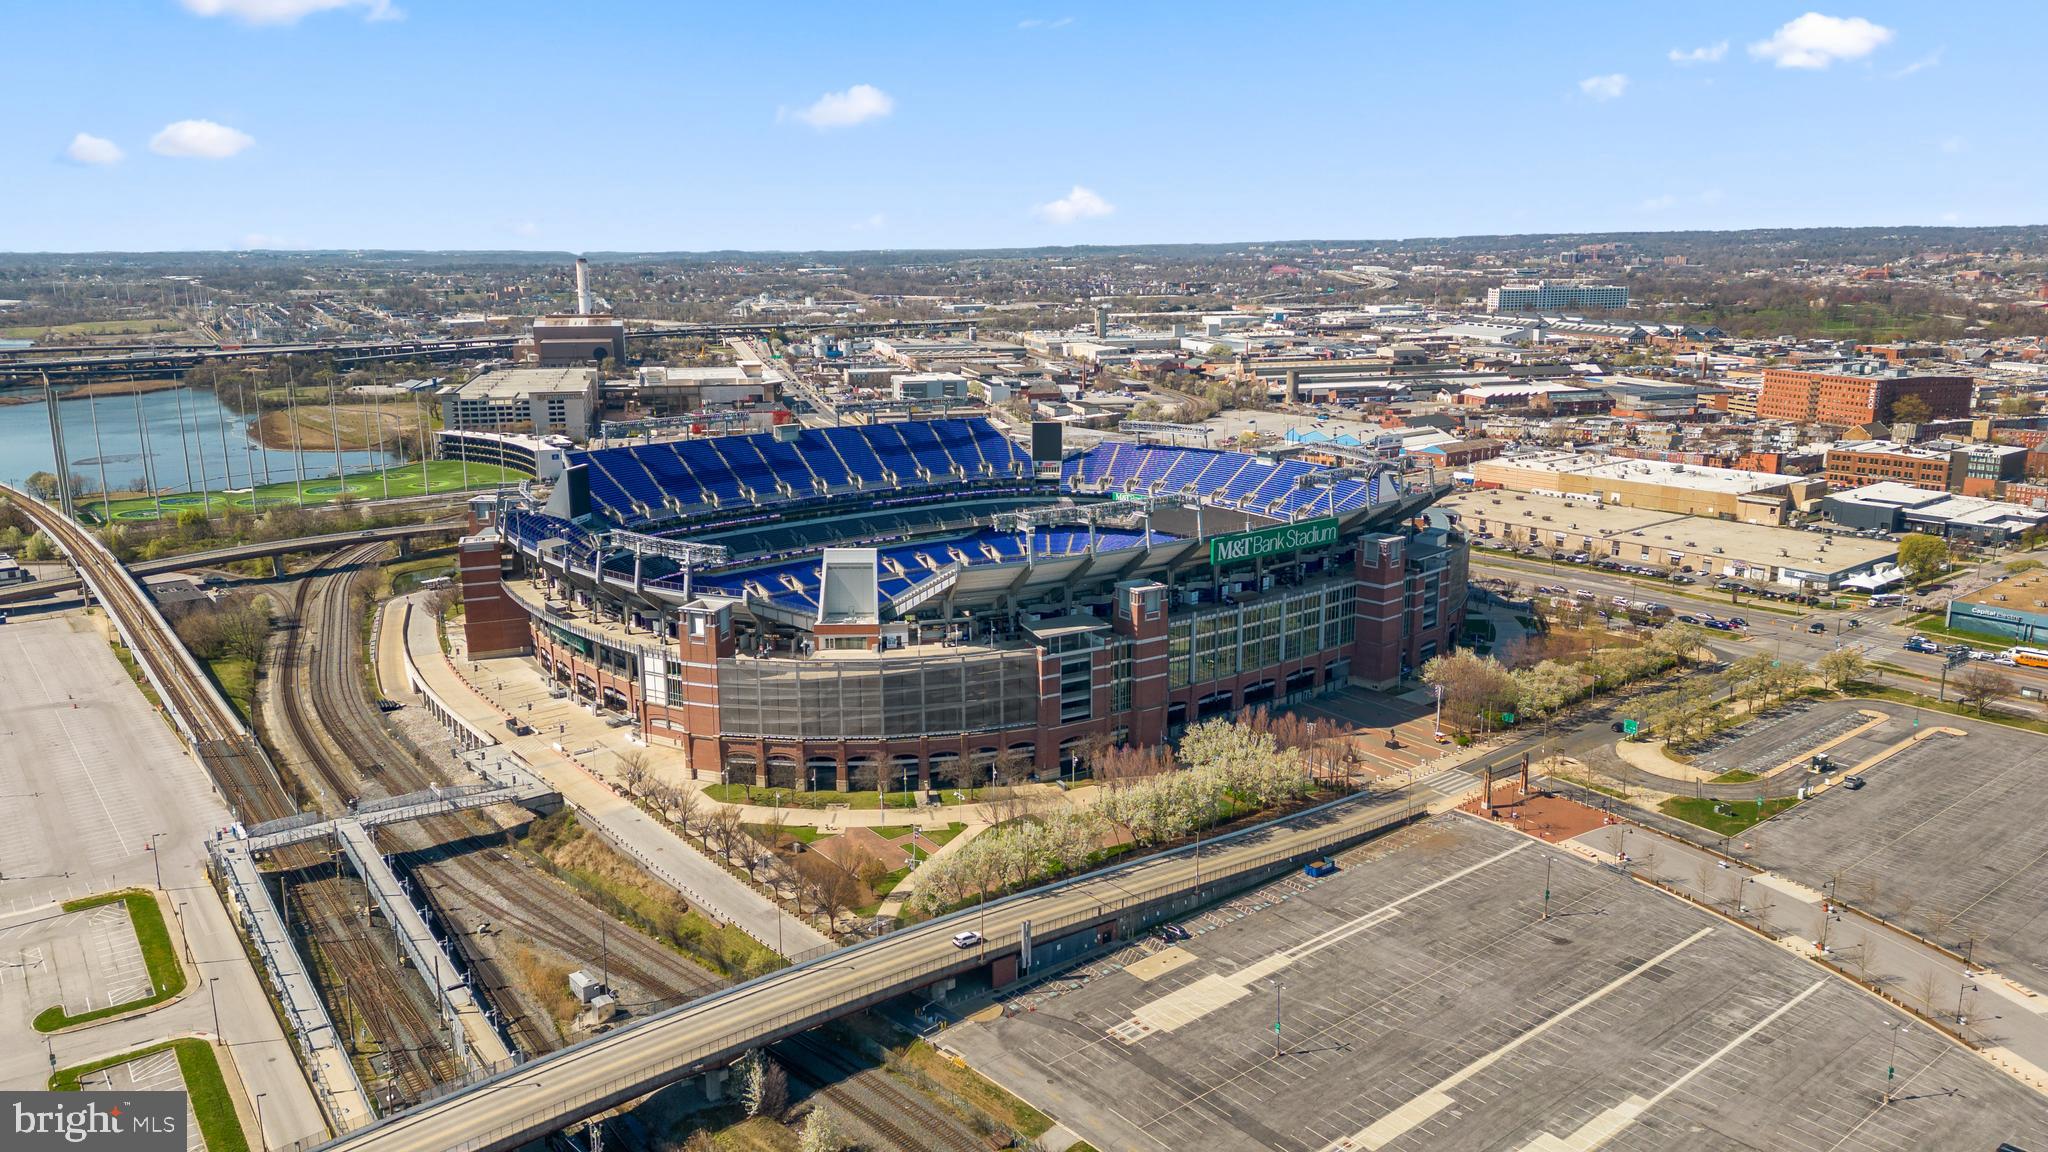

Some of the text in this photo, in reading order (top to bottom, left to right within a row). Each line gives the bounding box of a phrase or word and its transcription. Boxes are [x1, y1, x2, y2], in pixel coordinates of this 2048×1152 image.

[1217, 526, 1336, 561] M&T Bank Stadium
[1971, 607, 1996, 616] Capital
